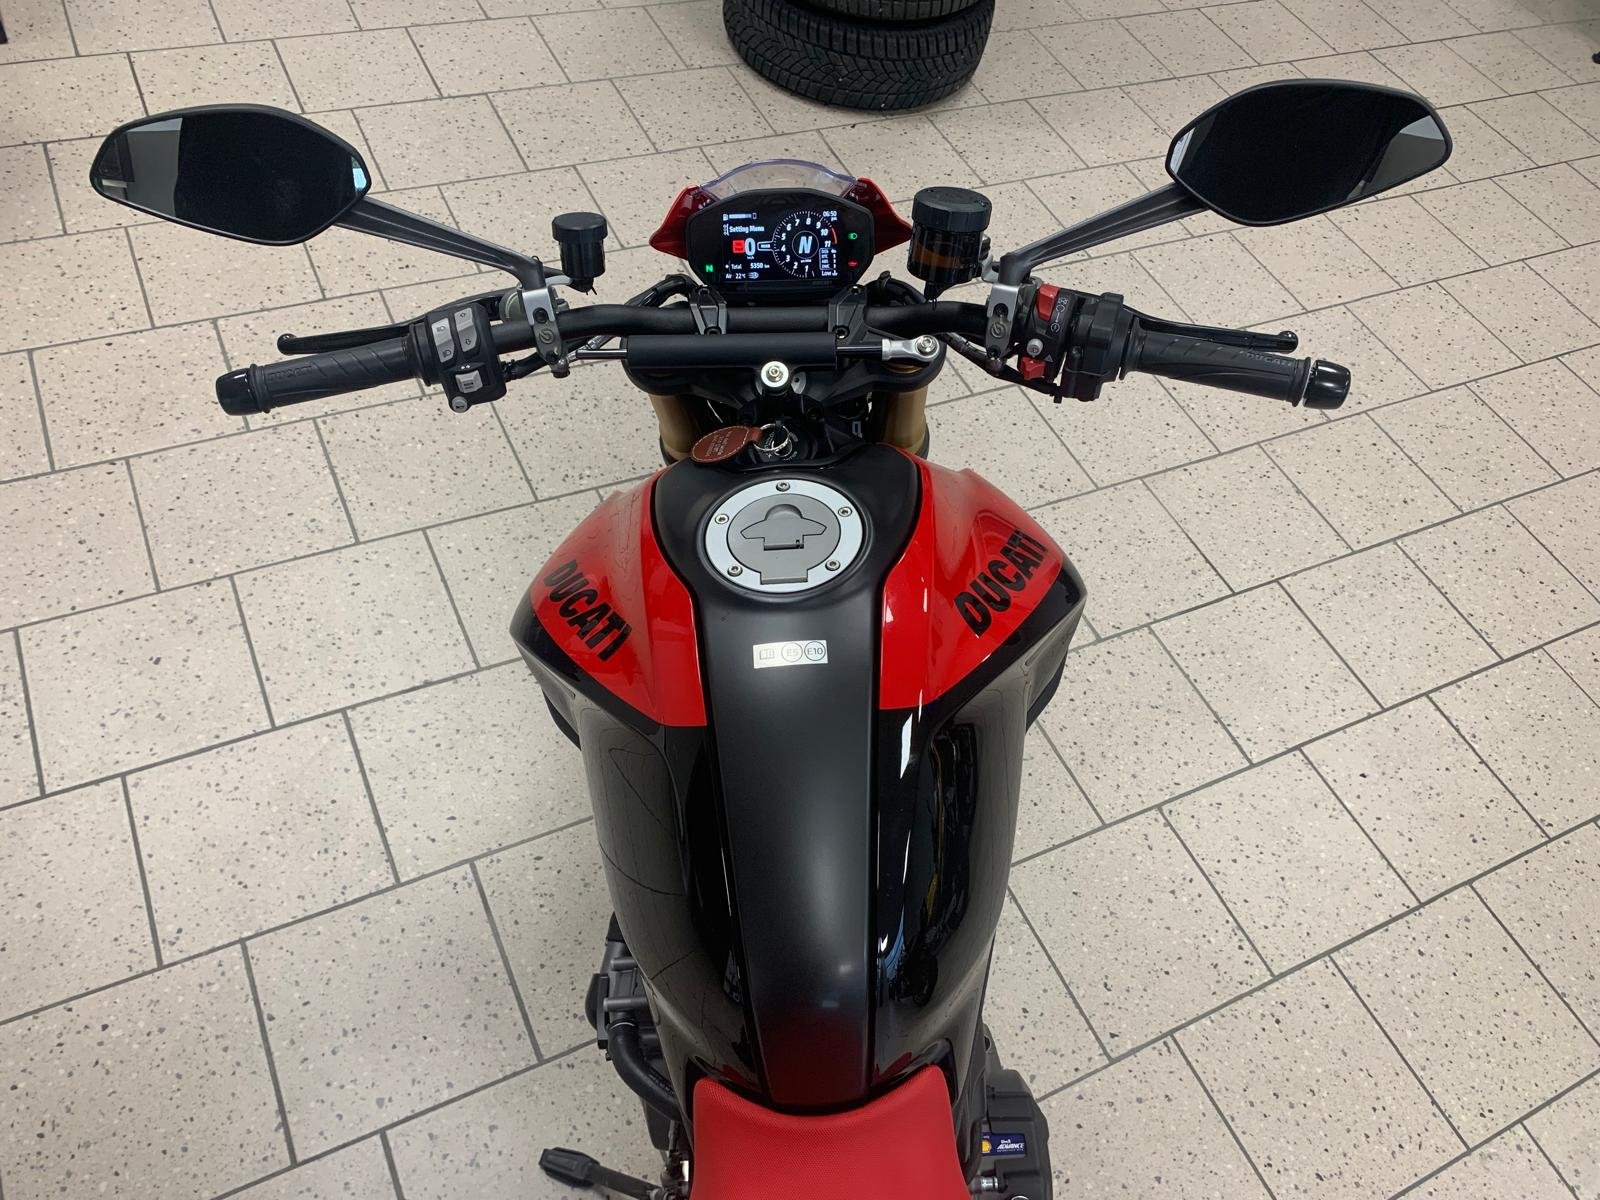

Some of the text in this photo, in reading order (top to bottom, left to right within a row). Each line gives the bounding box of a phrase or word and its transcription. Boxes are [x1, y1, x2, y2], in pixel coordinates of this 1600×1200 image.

[729, 225, 749, 234] Setting
[745, 238, 755, 256] 0
[799, 236, 812, 254] N
[954, 528, 1049, 638] DUCATI
[543, 559, 633, 662] DUCATI
[807, 647, 823, 656] E10
